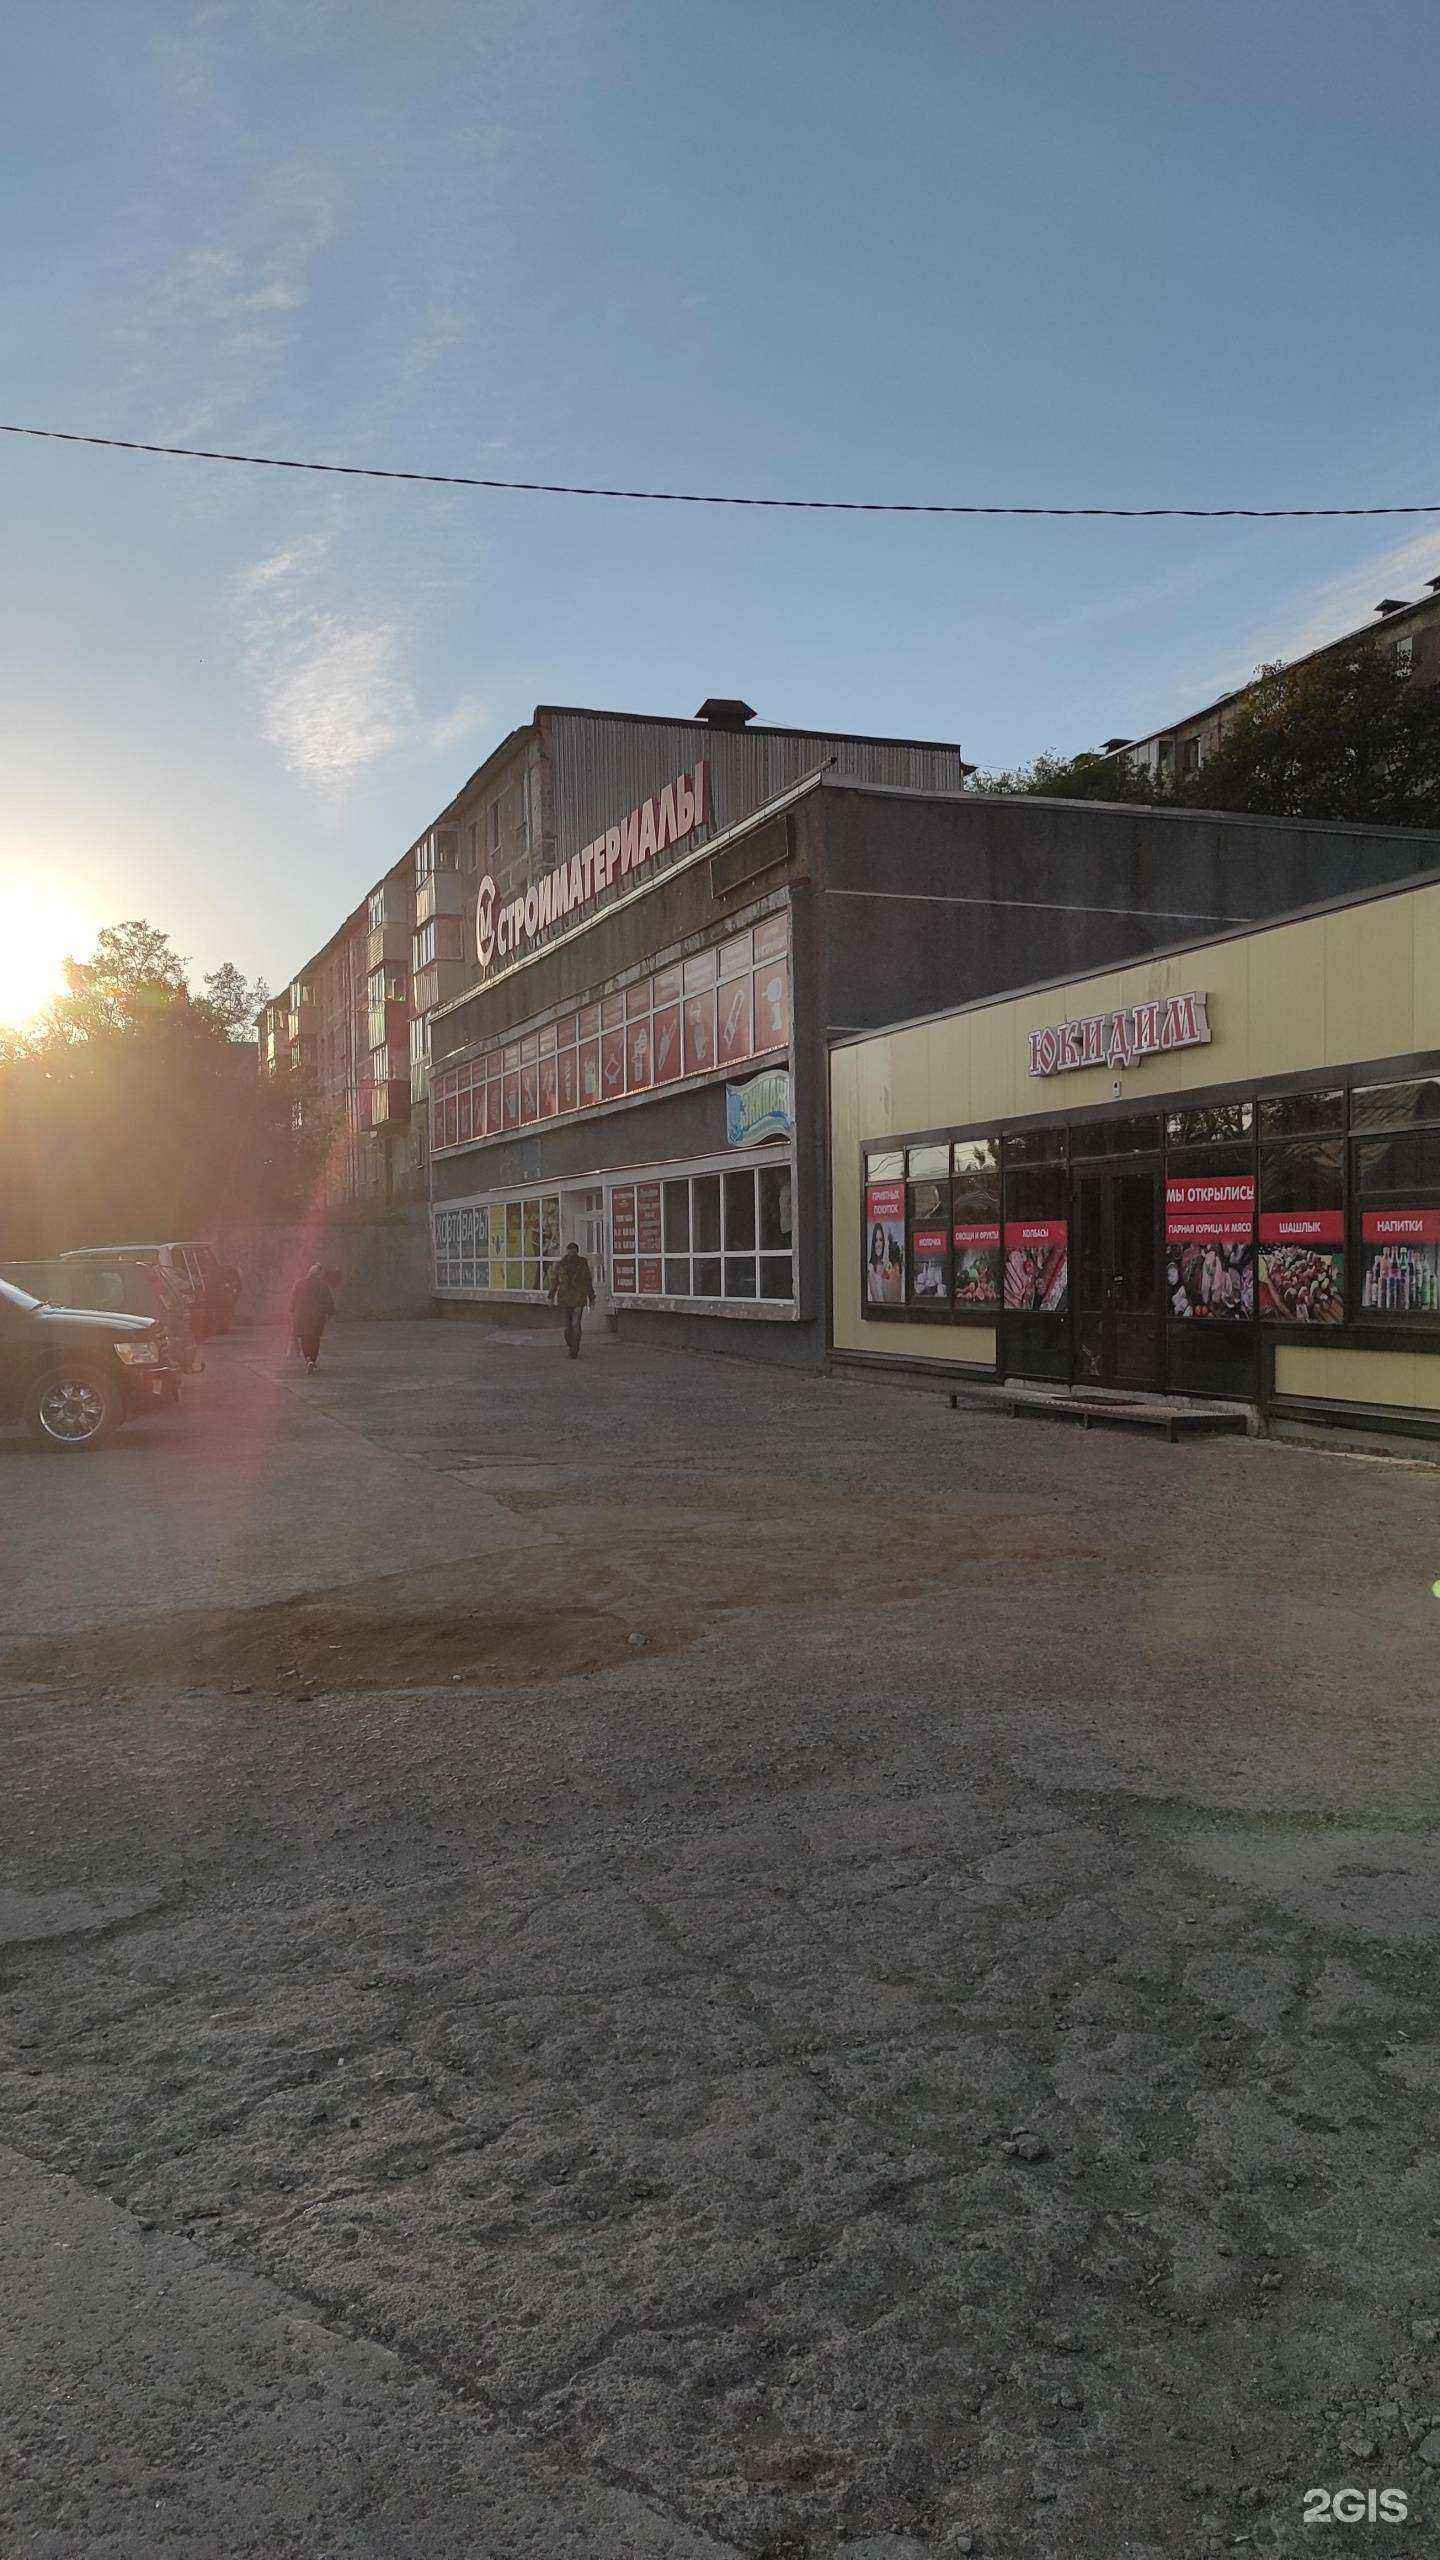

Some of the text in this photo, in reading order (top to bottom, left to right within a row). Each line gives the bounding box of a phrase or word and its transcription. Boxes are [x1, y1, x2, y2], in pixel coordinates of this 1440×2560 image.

[1028, 991, 1204, 1077] ЮКИДИМ
[1166, 1188, 1184, 1203] МЫ
[1168, 1222, 1252, 1234] ПАРНАЯ КУРИЦА И МЯСО
[1279, 1221, 1321, 1234] ШАШЛЫК
[1377, 1219, 1423, 1232] НАПИТКИ
